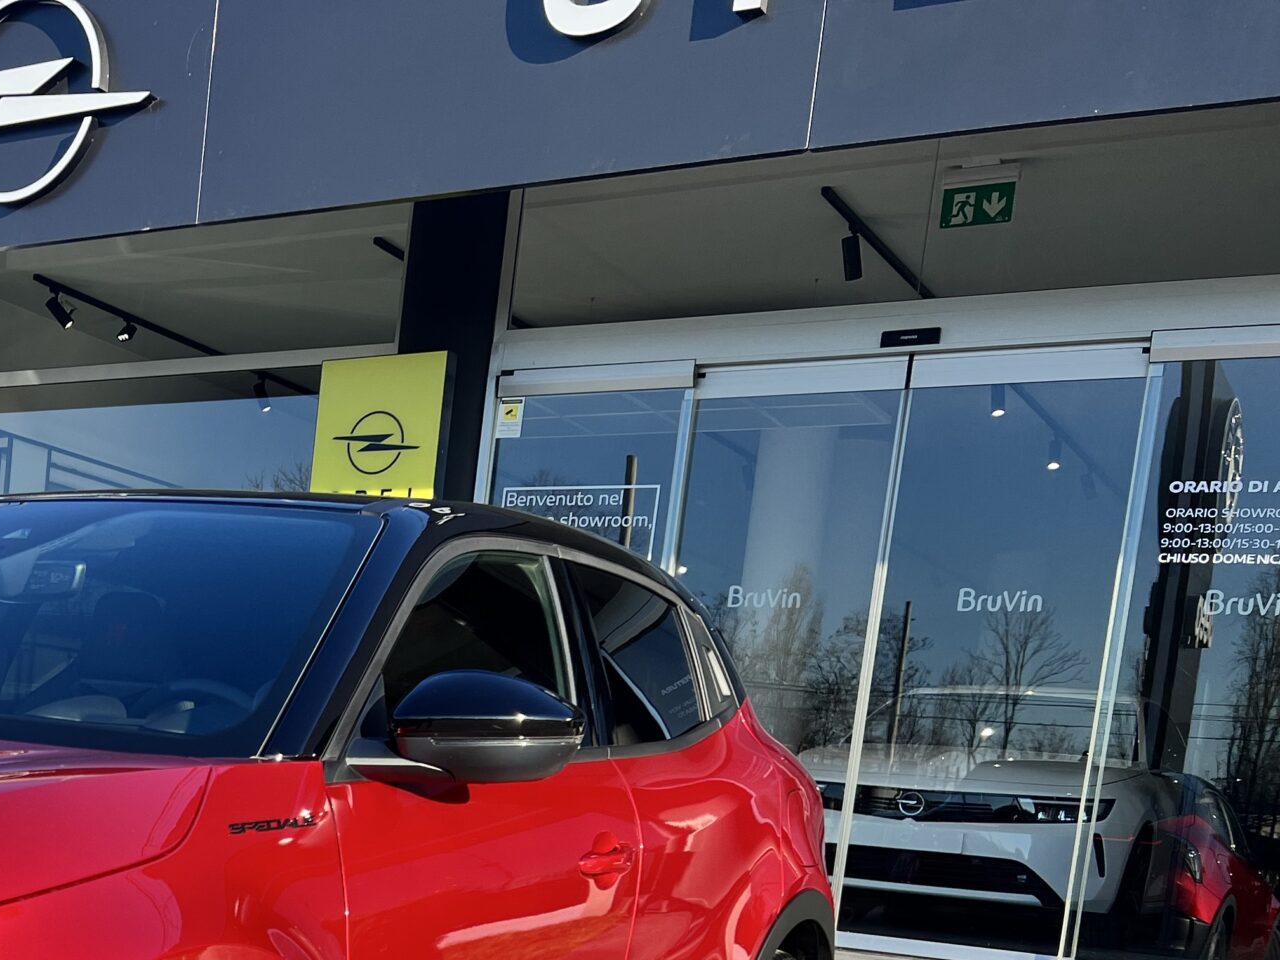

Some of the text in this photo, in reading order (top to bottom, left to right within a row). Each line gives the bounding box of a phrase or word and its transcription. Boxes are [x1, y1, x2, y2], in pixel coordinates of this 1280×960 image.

[1169, 480, 1243, 493] ORARIO
[1247, 480, 1269, 493] DI
[506, 489, 625, 507] Benvenuto nel
[559, 511, 653, 530] showroom,
[1165, 507, 1219, 518] ORARIO
[1158, 553, 1210, 564] CHIUSO
[727, 585, 801, 609] BruVin
[957, 587, 1043, 612] BruVin
